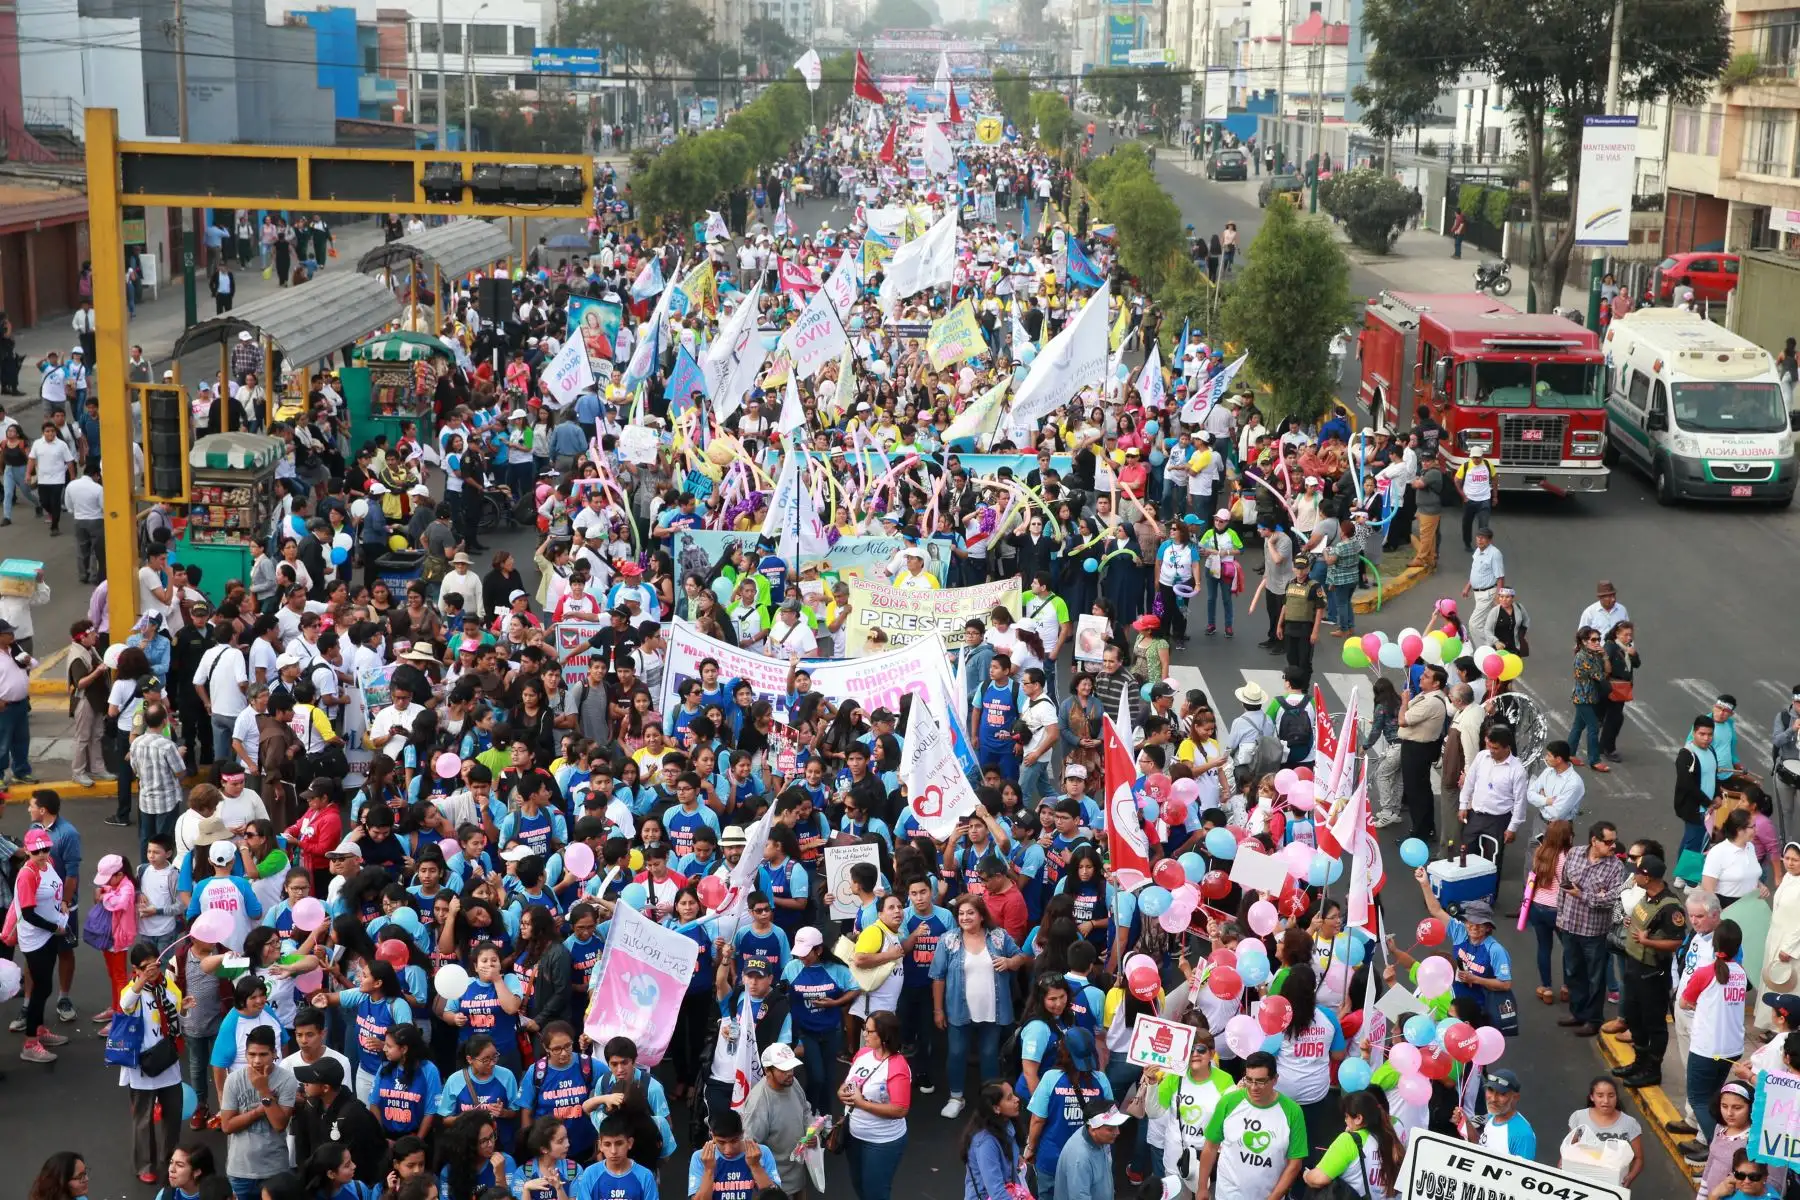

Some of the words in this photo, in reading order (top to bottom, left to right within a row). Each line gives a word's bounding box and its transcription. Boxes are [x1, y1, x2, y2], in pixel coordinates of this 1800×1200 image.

[852, 580, 908, 599] PARROQUIA
[911, 590, 930, 600] SAN
[934, 588, 969, 600] MIGUEL
[872, 593, 908, 609] ZONA
[912, 601, 920, 611] 9
[934, 600, 960, 614] RCC
[971, 596, 1001, 611] LIMA
[860, 609, 992, 632] PRESENT
[846, 659, 920, 692] MARCHA
[208, 887, 236, 896] MARCHA
[747, 959, 766, 969] EMS
[794, 983, 834, 993] VOLUNTARIO
[1724, 987, 1745, 1001] VIDA
[461, 999, 501, 1008] VOLUNTARI
[470, 1015, 495, 1027] VIDA
[1369, 1024, 1386, 1042] VIDA
[1294, 1042, 1324, 1057] VIDA
[559, 1080, 572, 1088] SOY
[380, 1088, 421, 1103] VOLUNTARIO
[543, 1085, 587, 1099] VOLUNTARIO
[1178, 1093, 1194, 1105] YO
[388, 1099, 399, 1107] POR
[401, 1100, 409, 1108] LA
[555, 1098, 571, 1107] POR
[573, 1096, 580, 1105] LA
[384, 1107, 412, 1123] VIDA
[553, 1103, 582, 1119] VIDA
[1180, 1125, 1204, 1137] VIDA
[1243, 1117, 1262, 1131] YO
[1240, 1151, 1272, 1168] VIDA
[727, 1172, 741, 1180] SOY
[1447, 1154, 1474, 1173] IE
[1520, 1176, 1589, 1200] 6047
[1416, 1169, 1457, 1200] JOSE
[539, 1190, 553, 1199] SOY
[611, 1189, 626, 1199] SOY
[721, 1192, 735, 1200] POR
[737, 1192, 746, 1200] LA
